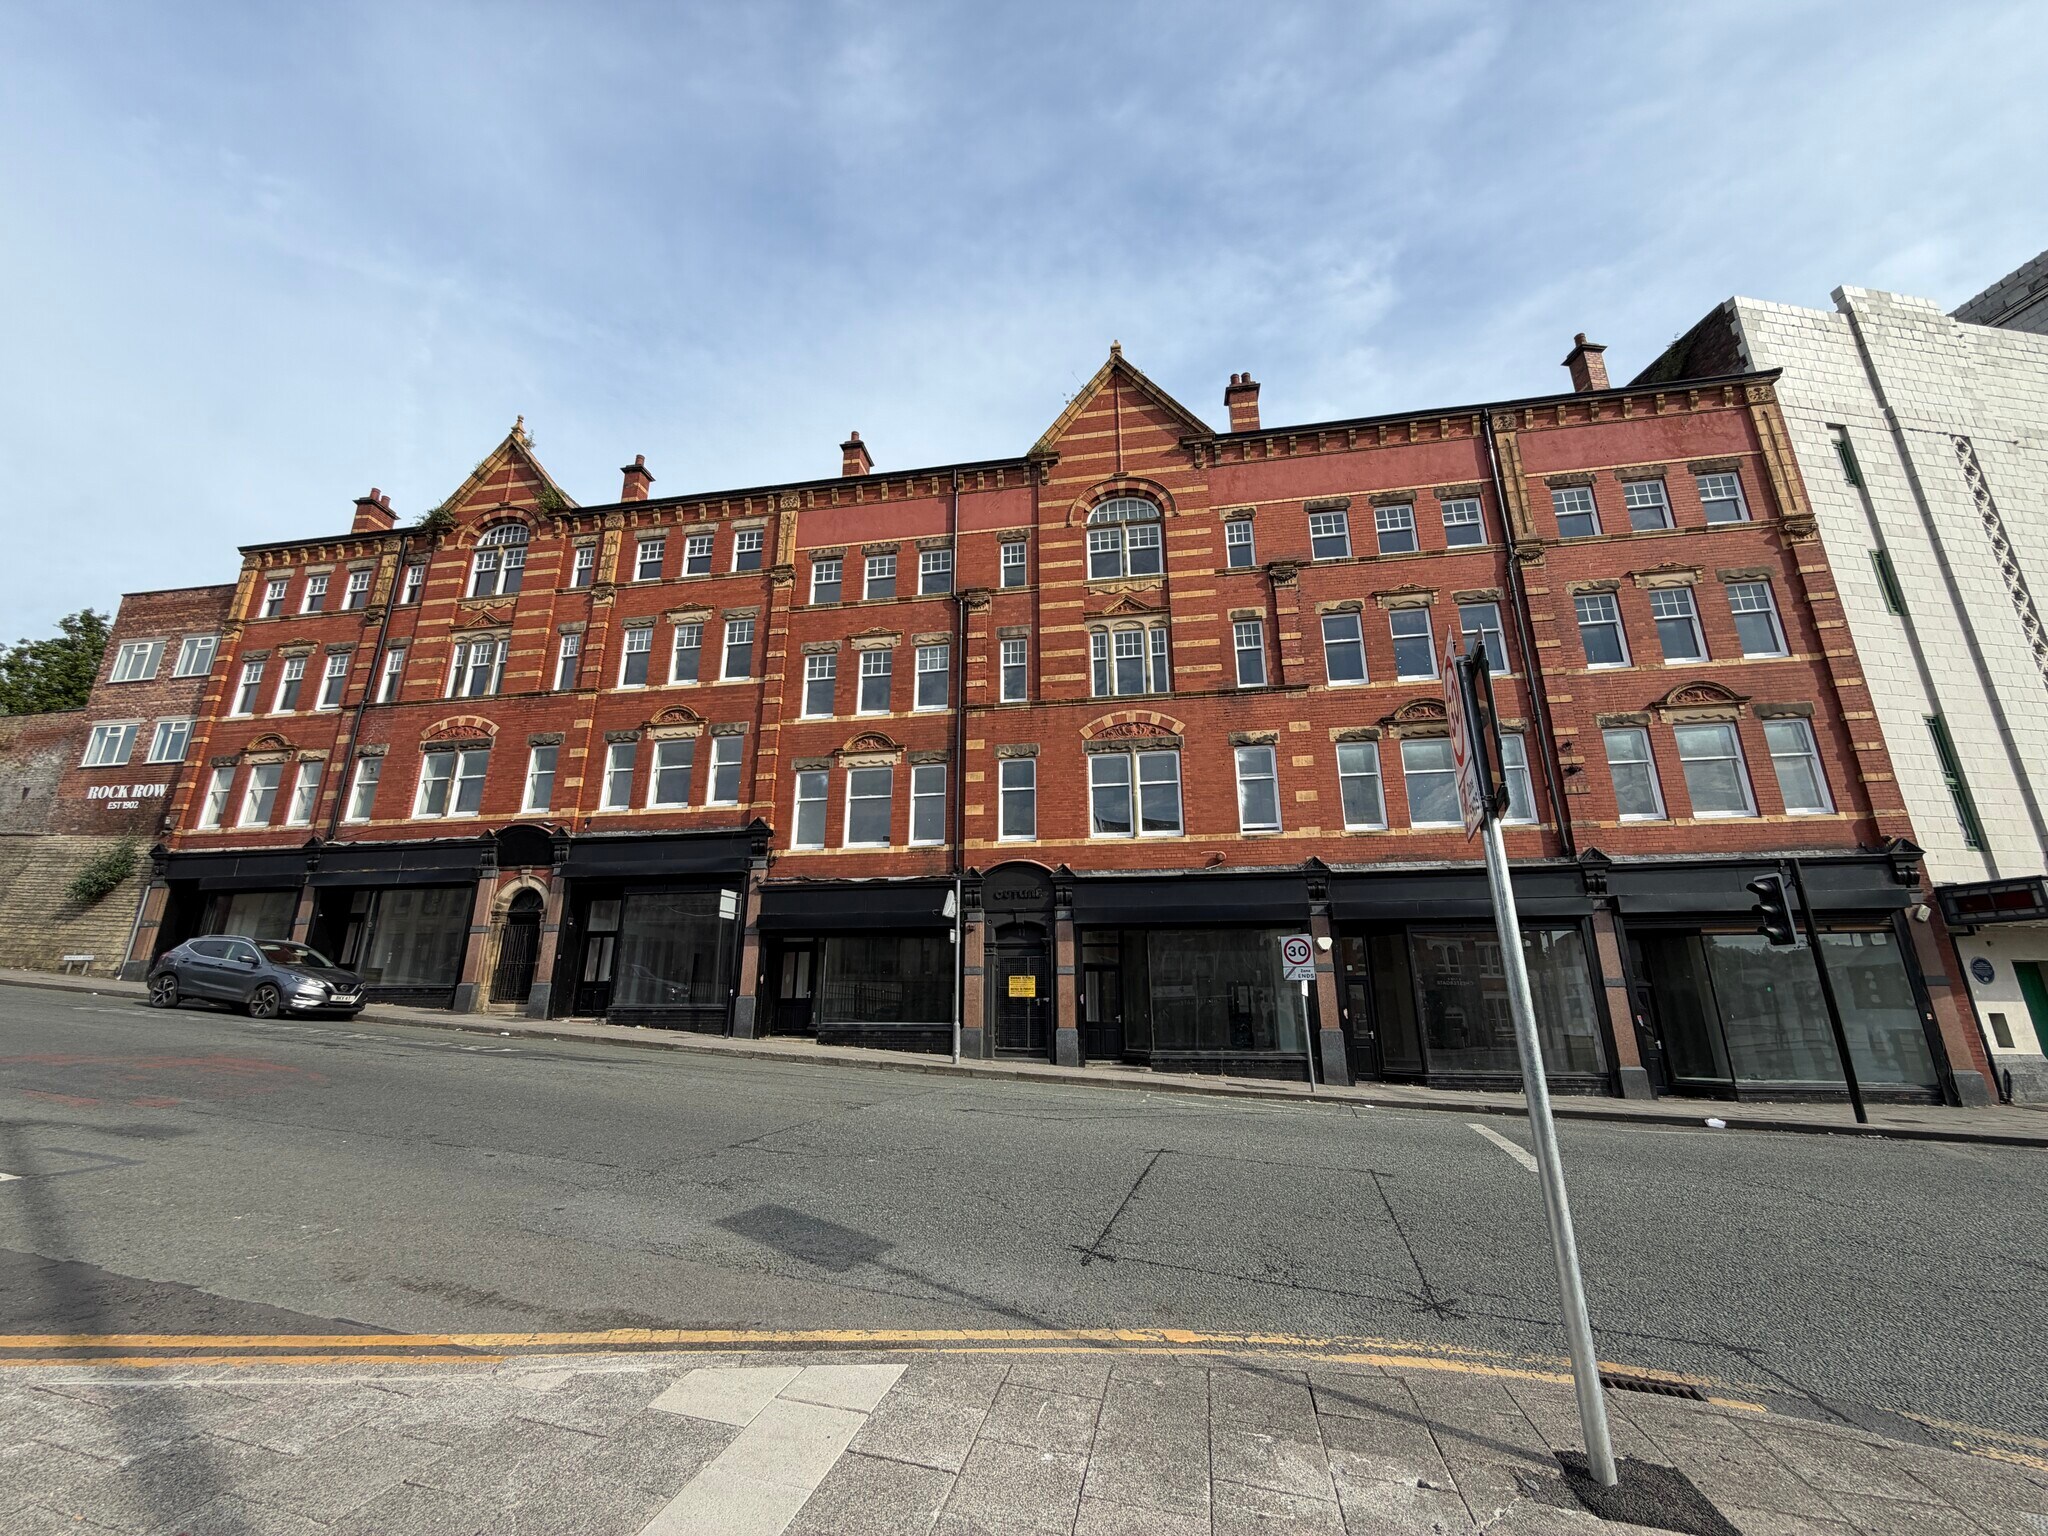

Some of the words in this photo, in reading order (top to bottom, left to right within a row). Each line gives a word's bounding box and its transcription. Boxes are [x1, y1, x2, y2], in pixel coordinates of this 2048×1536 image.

[87, 785, 130, 799] ROCK
[132, 784, 169, 798] ROW
[107, 802, 122, 810] EST
[1288, 946, 1306, 956] 30
